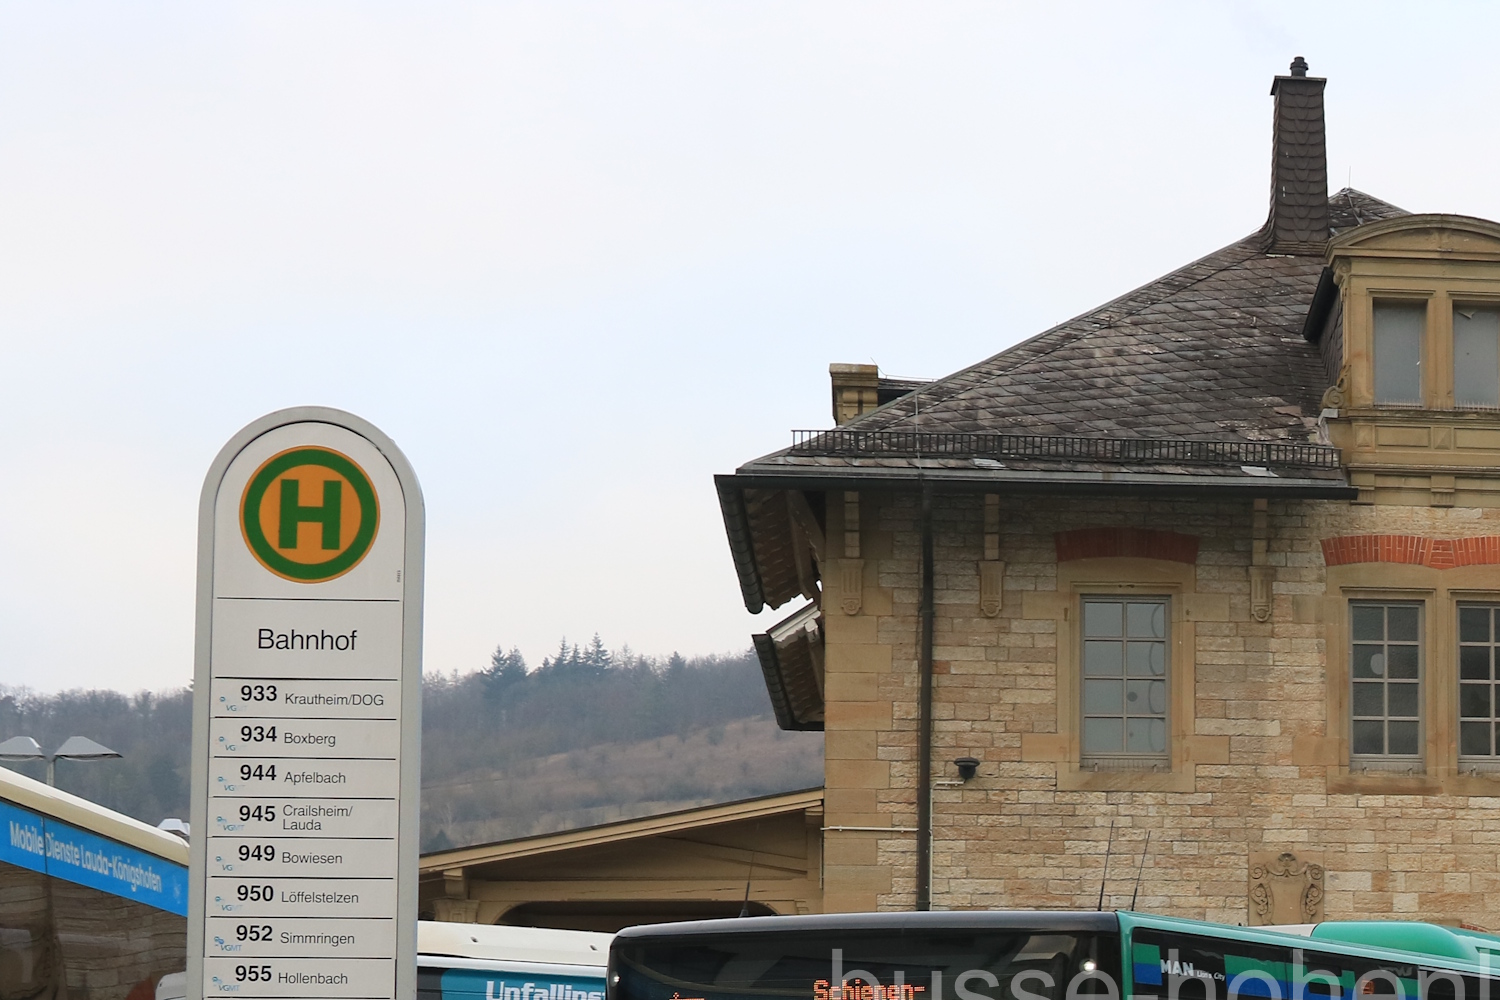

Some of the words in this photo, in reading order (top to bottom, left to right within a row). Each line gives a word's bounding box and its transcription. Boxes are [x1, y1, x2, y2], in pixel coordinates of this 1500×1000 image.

[278, 479, 342, 550] H
[258, 629, 357, 650] Bahnhof
[240, 685, 277, 702] 933
[284, 693, 385, 707] Krautheim/DOG
[240, 725, 278, 743] 934
[283, 732, 336, 748] Boxberg
[239, 764, 277, 781] 944
[284, 771, 346, 785] Apfelbach
[238, 805, 276, 822] 945
[282, 804, 353, 818] Crailsheim/
[282, 818, 322, 831] Lauda
[9, 821, 44, 857] Mobile
[44, 832, 80, 867] Dienste
[81, 845, 162, 892] Lauda-Königshofen
[238, 845, 275, 861] 949
[282, 852, 343, 865] Bowiesen
[237, 885, 274, 902] 950
[281, 891, 359, 904] Löffelstelzen
[235, 925, 273, 942] 952
[280, 932, 355, 947] Simmringen
[235, 965, 272, 982] 955
[278, 972, 348, 985] Hollenbach
[1160, 958, 1194, 977] MAN
